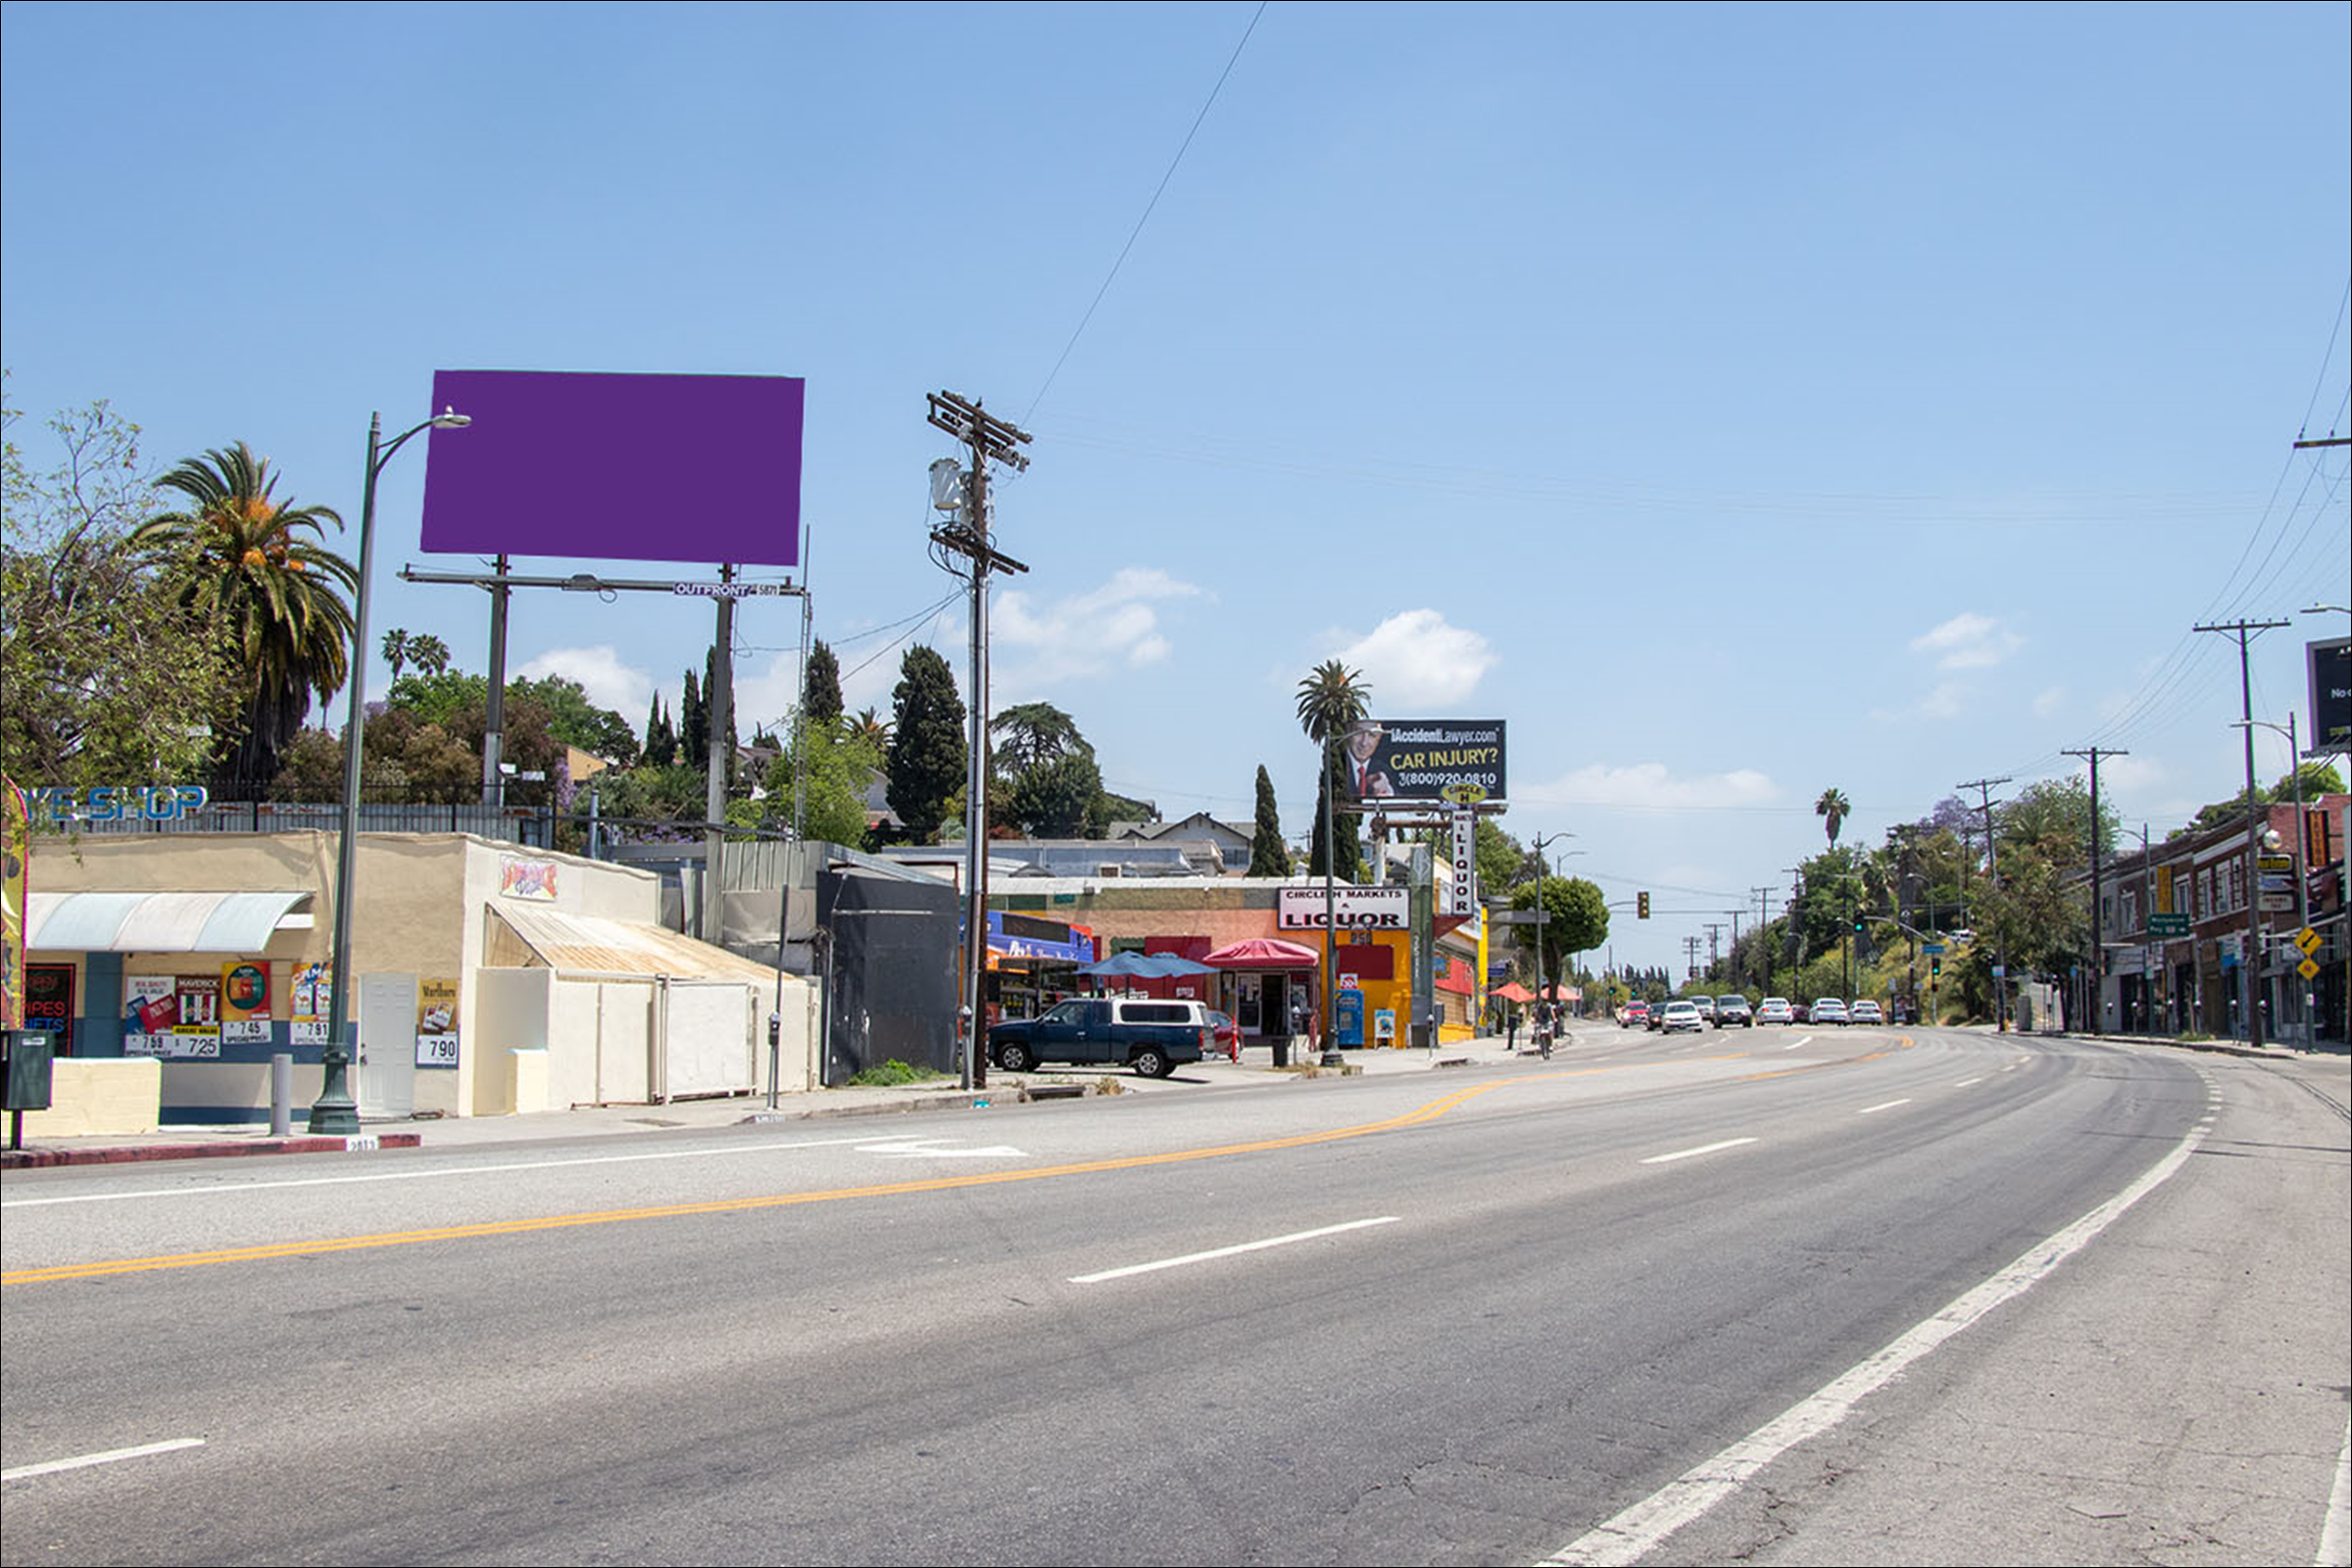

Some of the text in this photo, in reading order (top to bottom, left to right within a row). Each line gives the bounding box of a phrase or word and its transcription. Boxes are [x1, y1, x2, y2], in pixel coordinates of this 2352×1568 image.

[676, 581, 748, 597] OUTFRONT
[1391, 748, 1498, 770] CAR INJURY?
[1447, 784, 1481, 795] CIRCLE
[1460, 793, 1469, 802] H
[88, 786, 208, 819] SHOP
[1456, 834, 1468, 911] LIQUOR
[1286, 913, 1400, 926] LIQUOR
[291, 968, 331, 984] CAME
[25, 1001, 66, 1016] IPES
[188, 1039, 218, 1054] 725
[429, 1041, 457, 1057] 790
